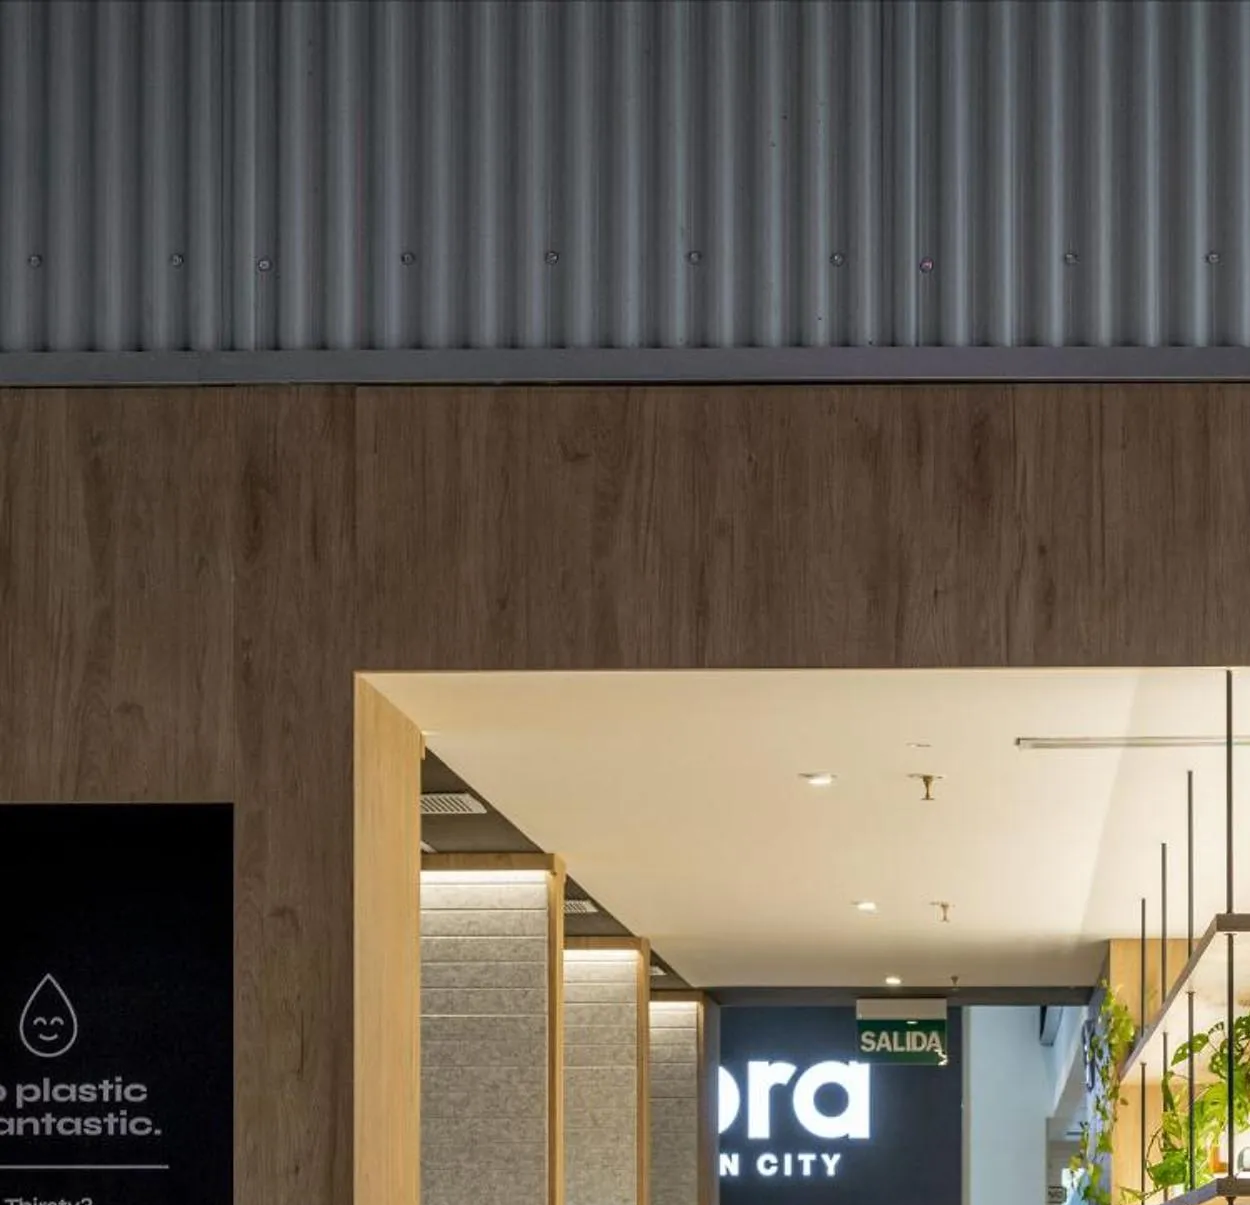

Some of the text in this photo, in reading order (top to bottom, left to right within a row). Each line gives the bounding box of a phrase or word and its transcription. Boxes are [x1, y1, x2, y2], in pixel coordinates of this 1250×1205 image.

[861, 1031, 943, 1053] SALIDA
[16, 1076, 148, 1108] plastic
[718, 1060, 871, 1140] ra
[756, 1153, 841, 1177] CITY
